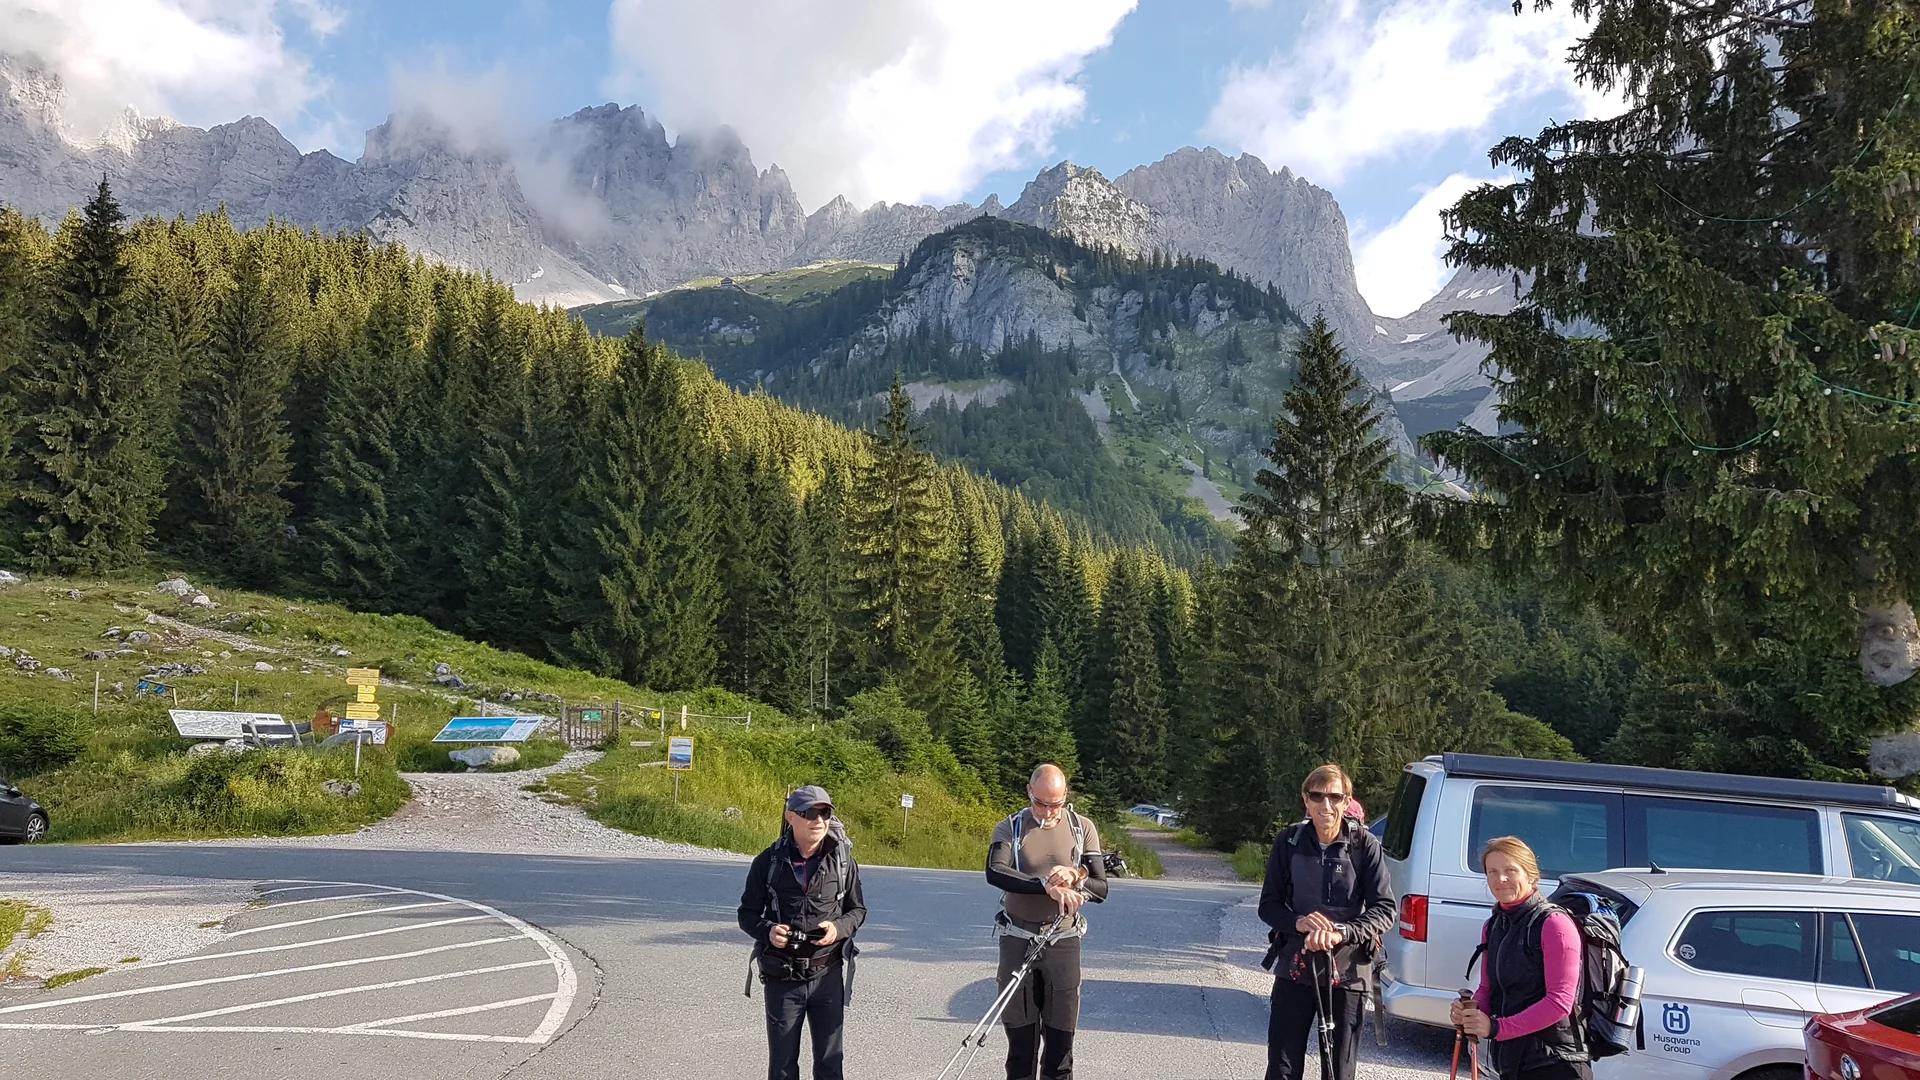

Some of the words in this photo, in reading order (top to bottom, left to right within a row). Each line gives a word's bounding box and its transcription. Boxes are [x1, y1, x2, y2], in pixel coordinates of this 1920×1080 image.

[1669, 1012, 1684, 1029] H
[1653, 1033, 1701, 1046] Husqvarna
[1663, 1043, 1691, 1055] Group
